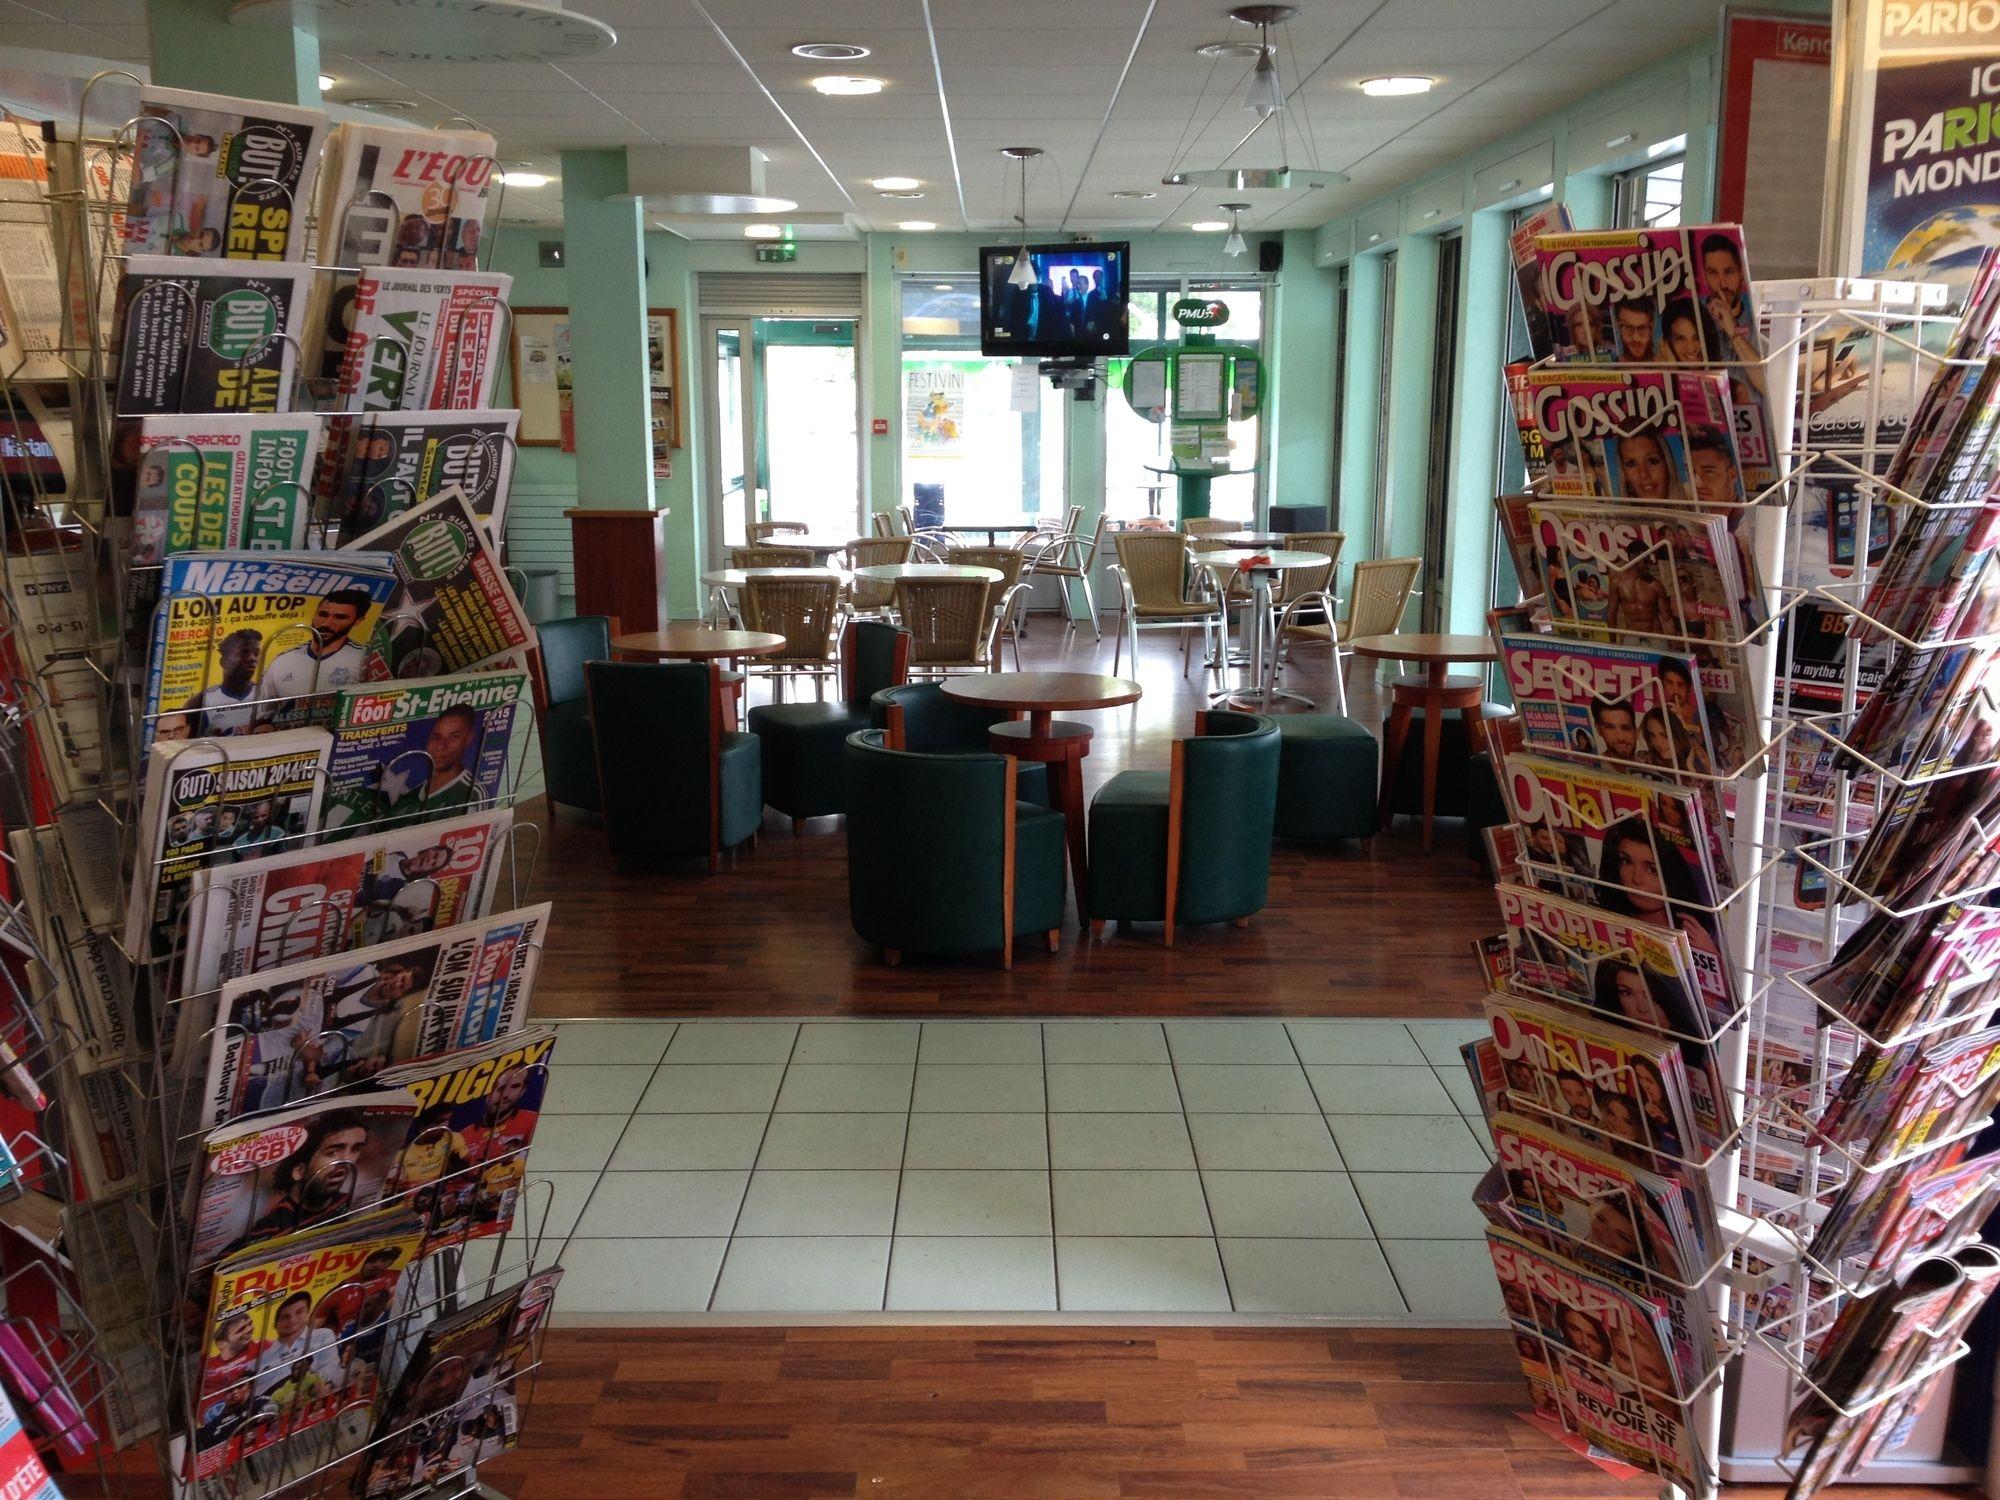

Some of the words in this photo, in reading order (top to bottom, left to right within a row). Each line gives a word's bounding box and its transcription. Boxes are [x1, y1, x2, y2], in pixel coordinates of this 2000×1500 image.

[238, 134, 287, 184] BUT!
[393, 148, 492, 187] L'ÉQU
[1550, 230, 1694, 314] Gossip!
[163, 280, 177, 314] icky
[176, 280, 189, 306] hut
[272, 294, 287, 319] SUR
[223, 300, 269, 350] BUT!
[418, 312, 432, 330] LE
[1178, 308, 1206, 319] PMU
[402, 335, 427, 401] JOURNAL
[401, 425, 424, 449] IL
[234, 450, 247, 485] GALTIER
[253, 437, 278, 491] INFOS
[274, 436, 298, 480] FOOT
[200, 461, 229, 507] LES
[391, 450, 419, 504] FAUT
[1553, 481, 1593, 493] MARIAE
[172, 463, 199, 547] COUPS
[231, 486, 244, 514] ATTEND
[197, 512, 224, 550] DE
[228, 515, 240, 548] ENCORE
[405, 521, 463, 578] BUT!
[233, 561, 260, 573] Le
[473, 558, 501, 599] BAISSE
[25, 581, 70, 595] CANA+
[497, 595, 511, 613] DU
[171, 617, 222, 629] 2014-205
[241, 612, 277, 623] chauffe
[172, 600, 222, 620] L'OM
[228, 597, 257, 615] AU
[264, 595, 306, 612] TOP
[503, 609, 522, 639] PRIX
[169, 627, 225, 642] MERCAO
[1510, 650, 1655, 712] SECRET!
[1803, 664, 1836, 680] mythe
[351, 702, 392, 725] Foot
[339, 723, 408, 741] TRANSFERTS
[179, 772, 212, 799] BUT!
[216, 766, 266, 793] SAISON
[256, 883, 327, 972] CHA
[1502, 892, 1634, 952] PEOPLE
[443, 938, 476, 975] L'OM
[435, 978, 465, 1002] SUR
[501, 974, 522, 1015] VARGAS
[499, 1013, 512, 1026] ET
[1489, 1005, 1627, 1094] Oulala!
[214, 1042, 240, 1104] Batshuayi
[216, 1136, 301, 1175] RUGBY
[235, 1132, 282, 1155] JOURNAL
[285, 1124, 304, 1139] DU
[233, 1248, 371, 1305] Rugby
[1655, 1413, 1677, 1434] SE
